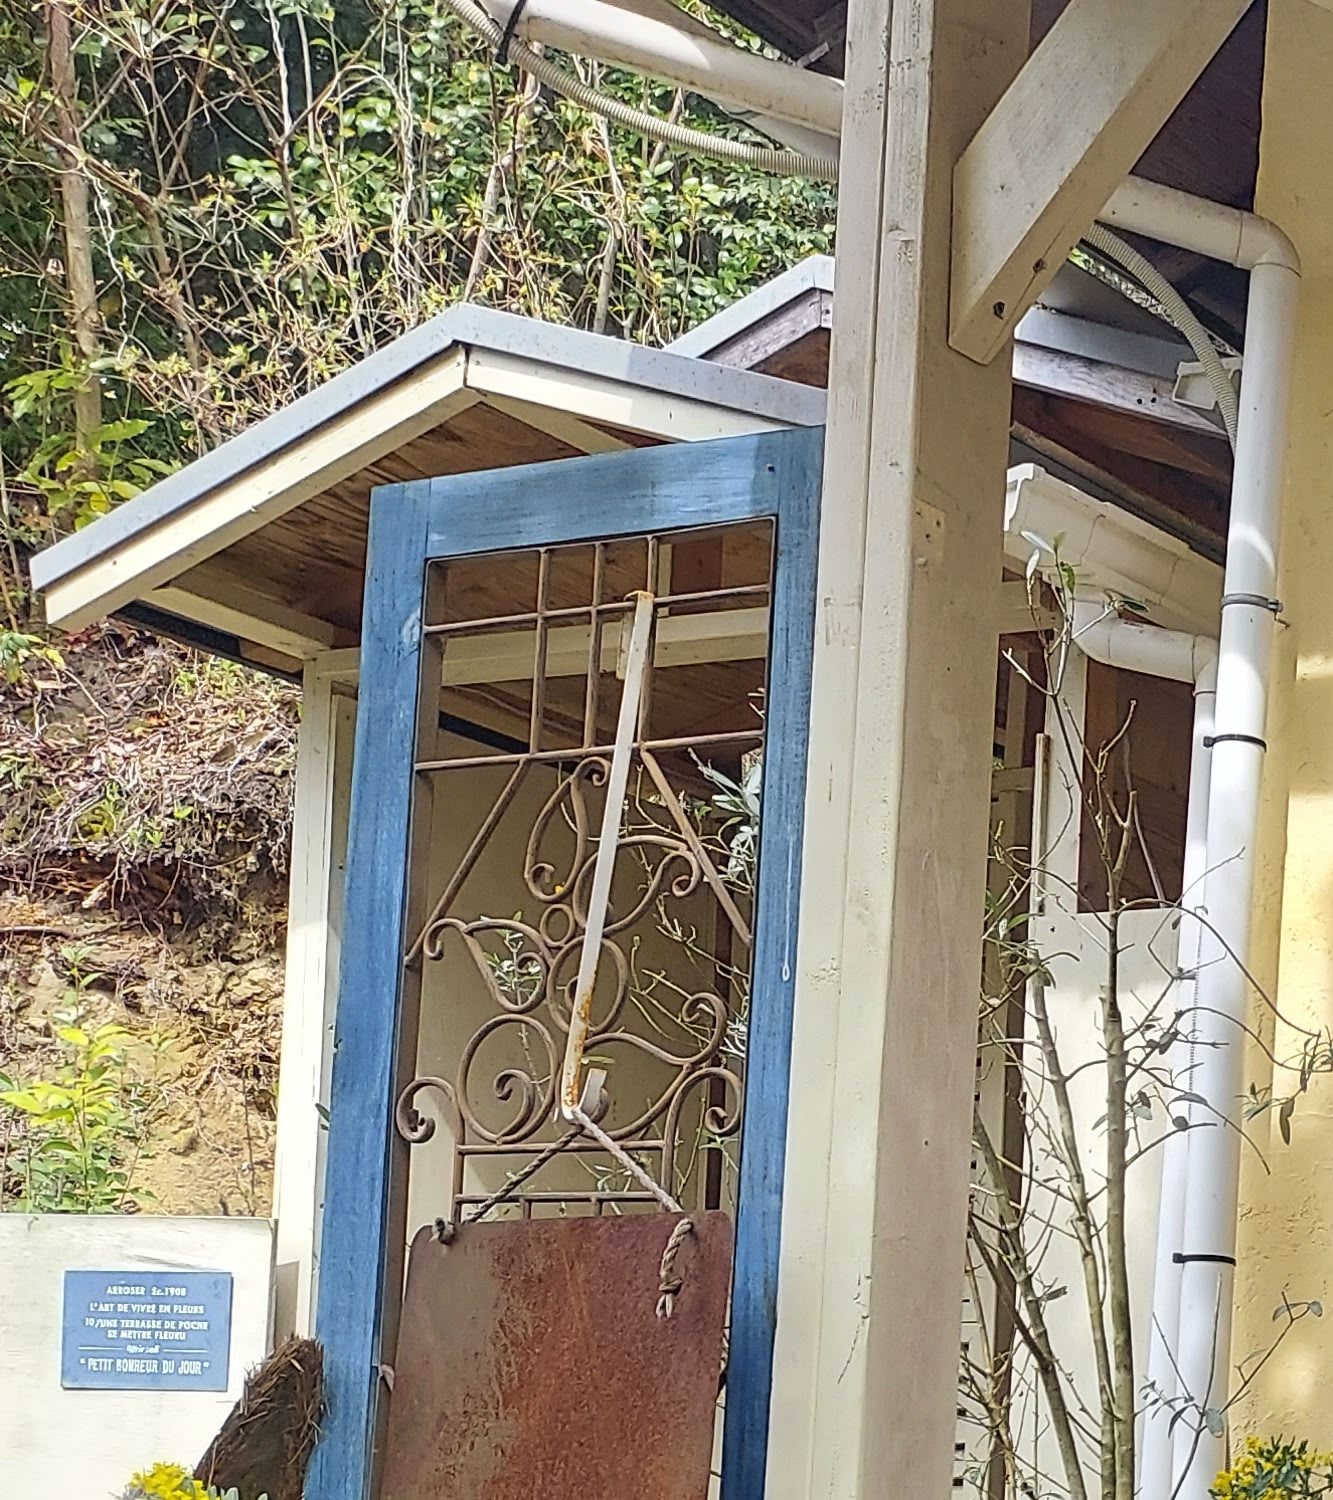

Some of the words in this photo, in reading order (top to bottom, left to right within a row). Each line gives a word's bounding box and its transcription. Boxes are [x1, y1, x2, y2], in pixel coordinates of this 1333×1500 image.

[117, 1303, 130, 1313] DE
[164, 1320, 177, 1331] DE
[162, 1360, 175, 1375] DU
